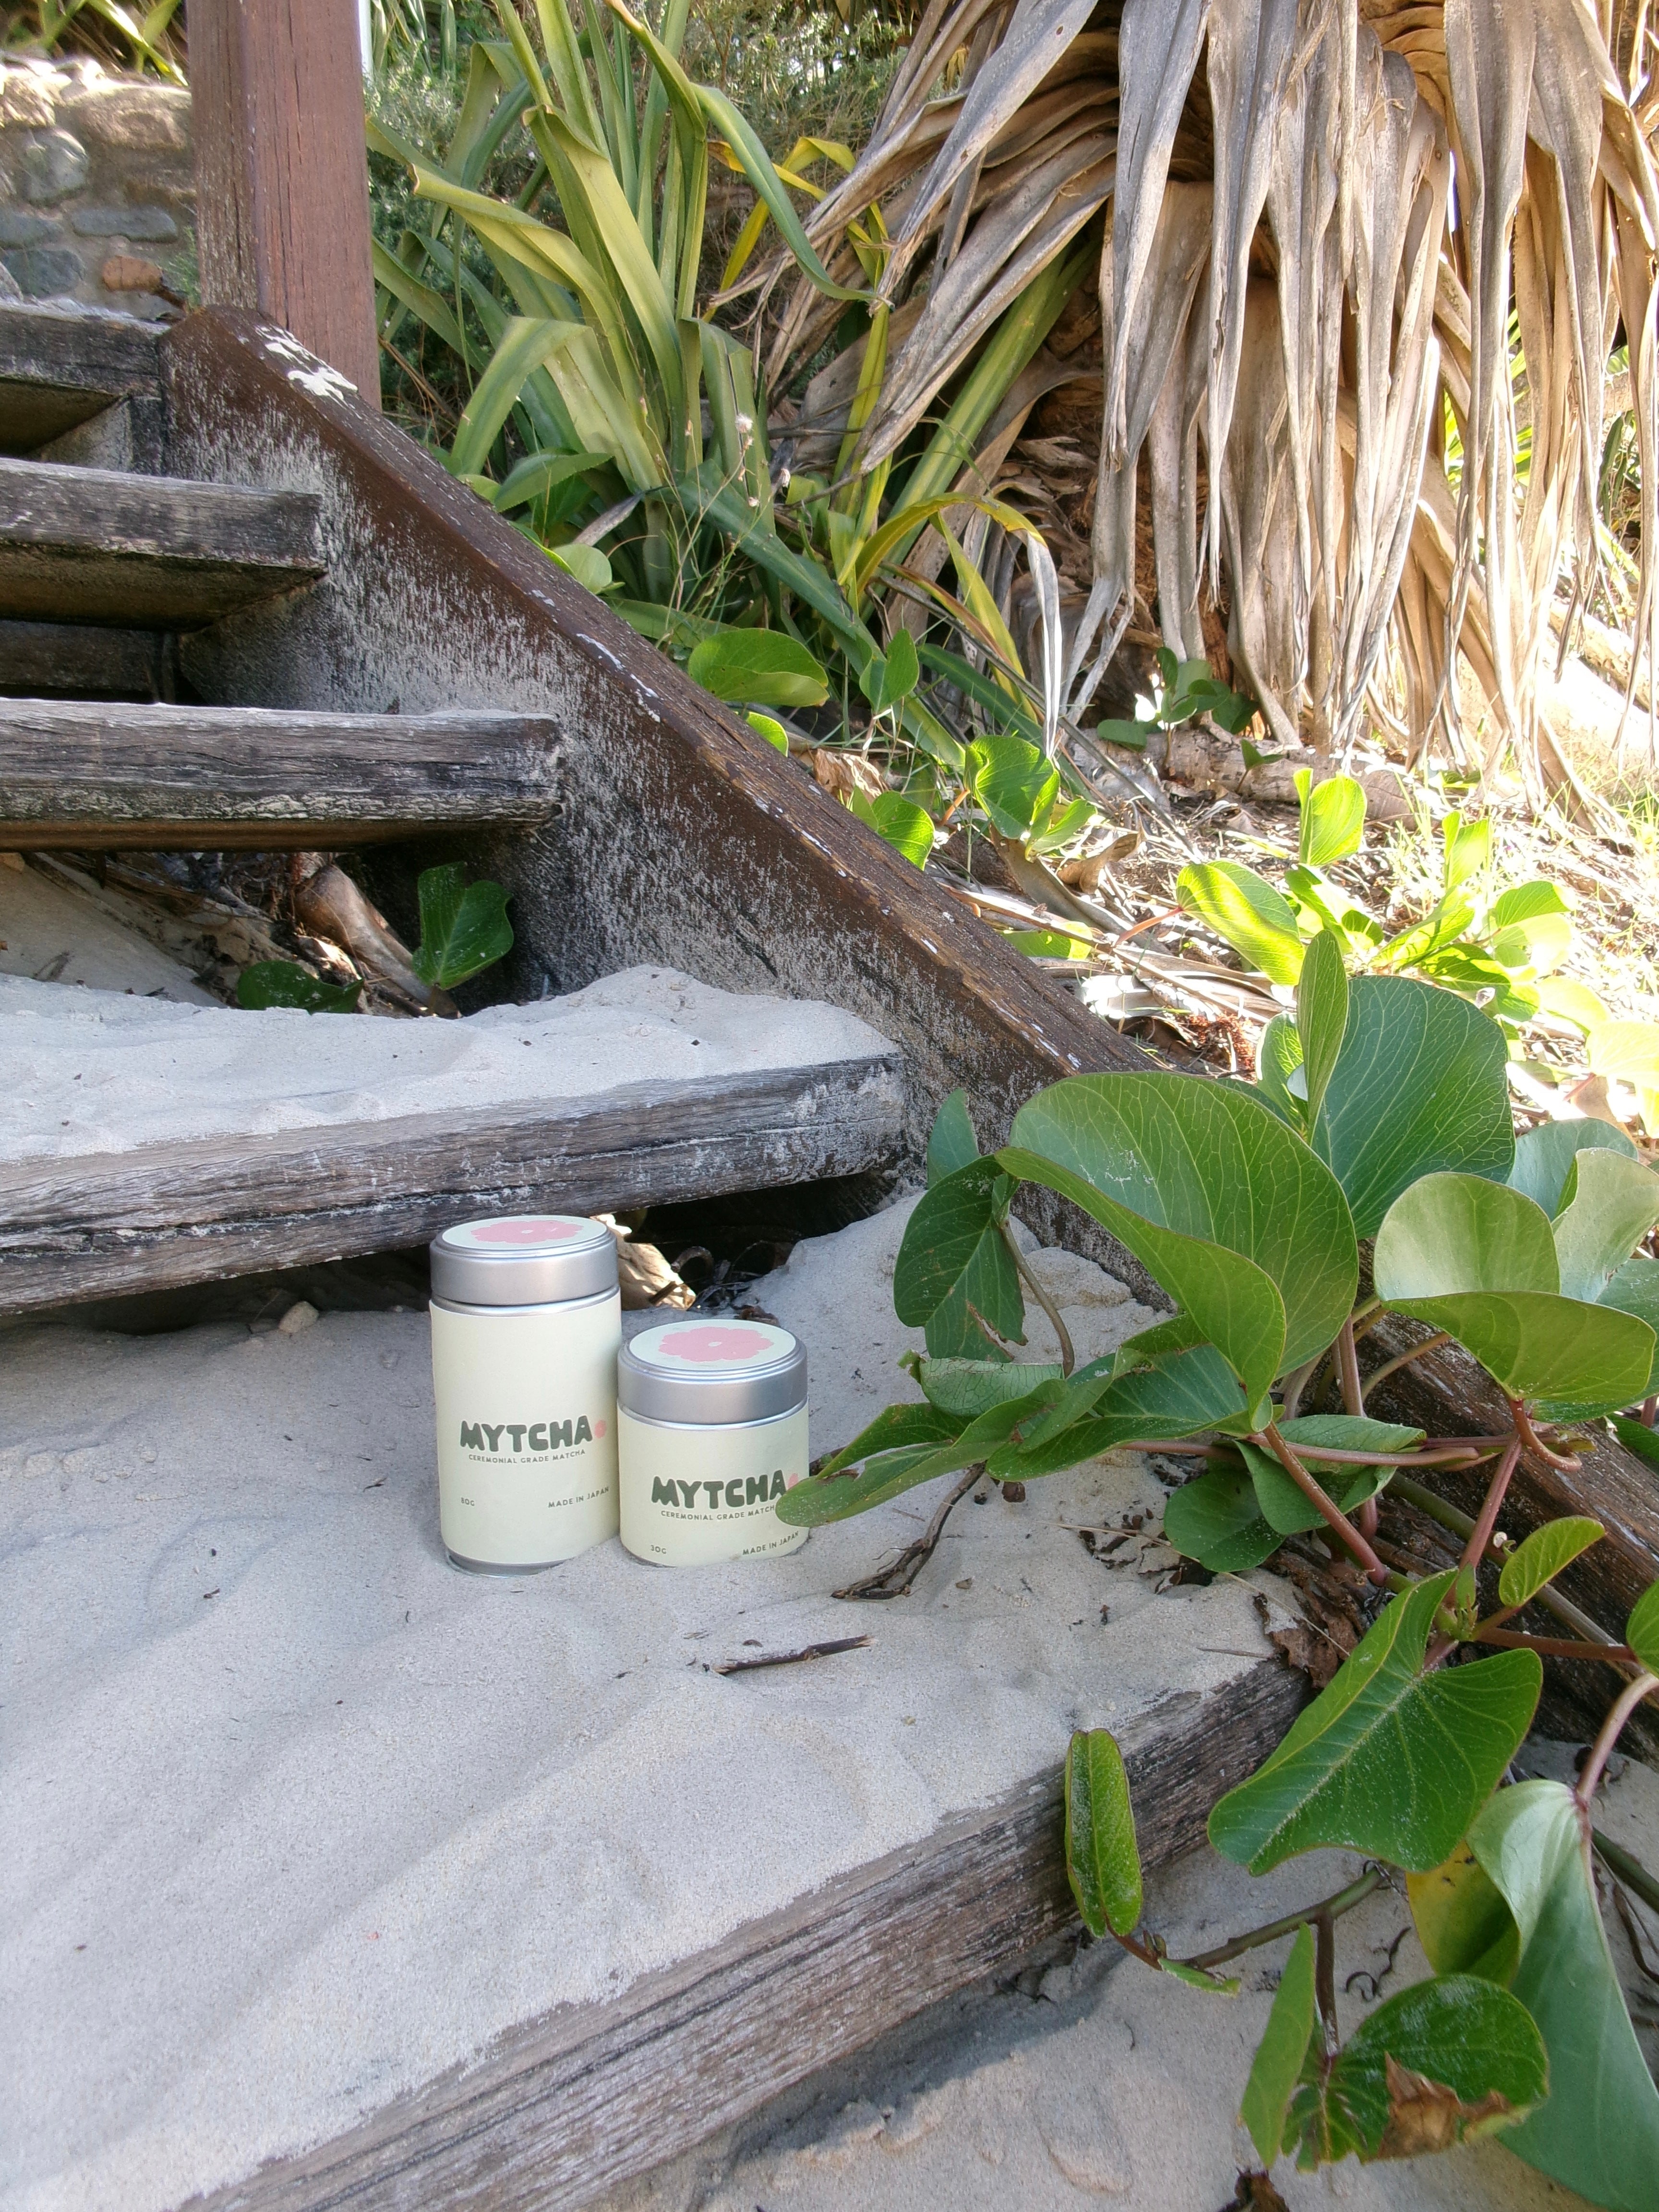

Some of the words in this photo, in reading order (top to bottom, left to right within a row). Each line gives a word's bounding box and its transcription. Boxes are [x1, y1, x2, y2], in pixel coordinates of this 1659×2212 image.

[460, 1415, 592, 1452] MYTCHA
[469, 1454, 517, 1464] CEREMONIAL
[553, 1449, 586, 1461] MATCHA
[548, 1499, 573, 1508] MADE
[587, 1487, 609, 1500] JAPAN
[651, 1469, 786, 1509] MYTCHA
[461, 1497, 475, 1506] 80G
[661, 1511, 713, 1520] CEREMONIAL
[748, 1506, 775, 1516] MATCH
[650, 1545, 667, 1554] 30G
[743, 1545, 767, 1555] MADE
[779, 1531, 799, 1546] JAPAN
